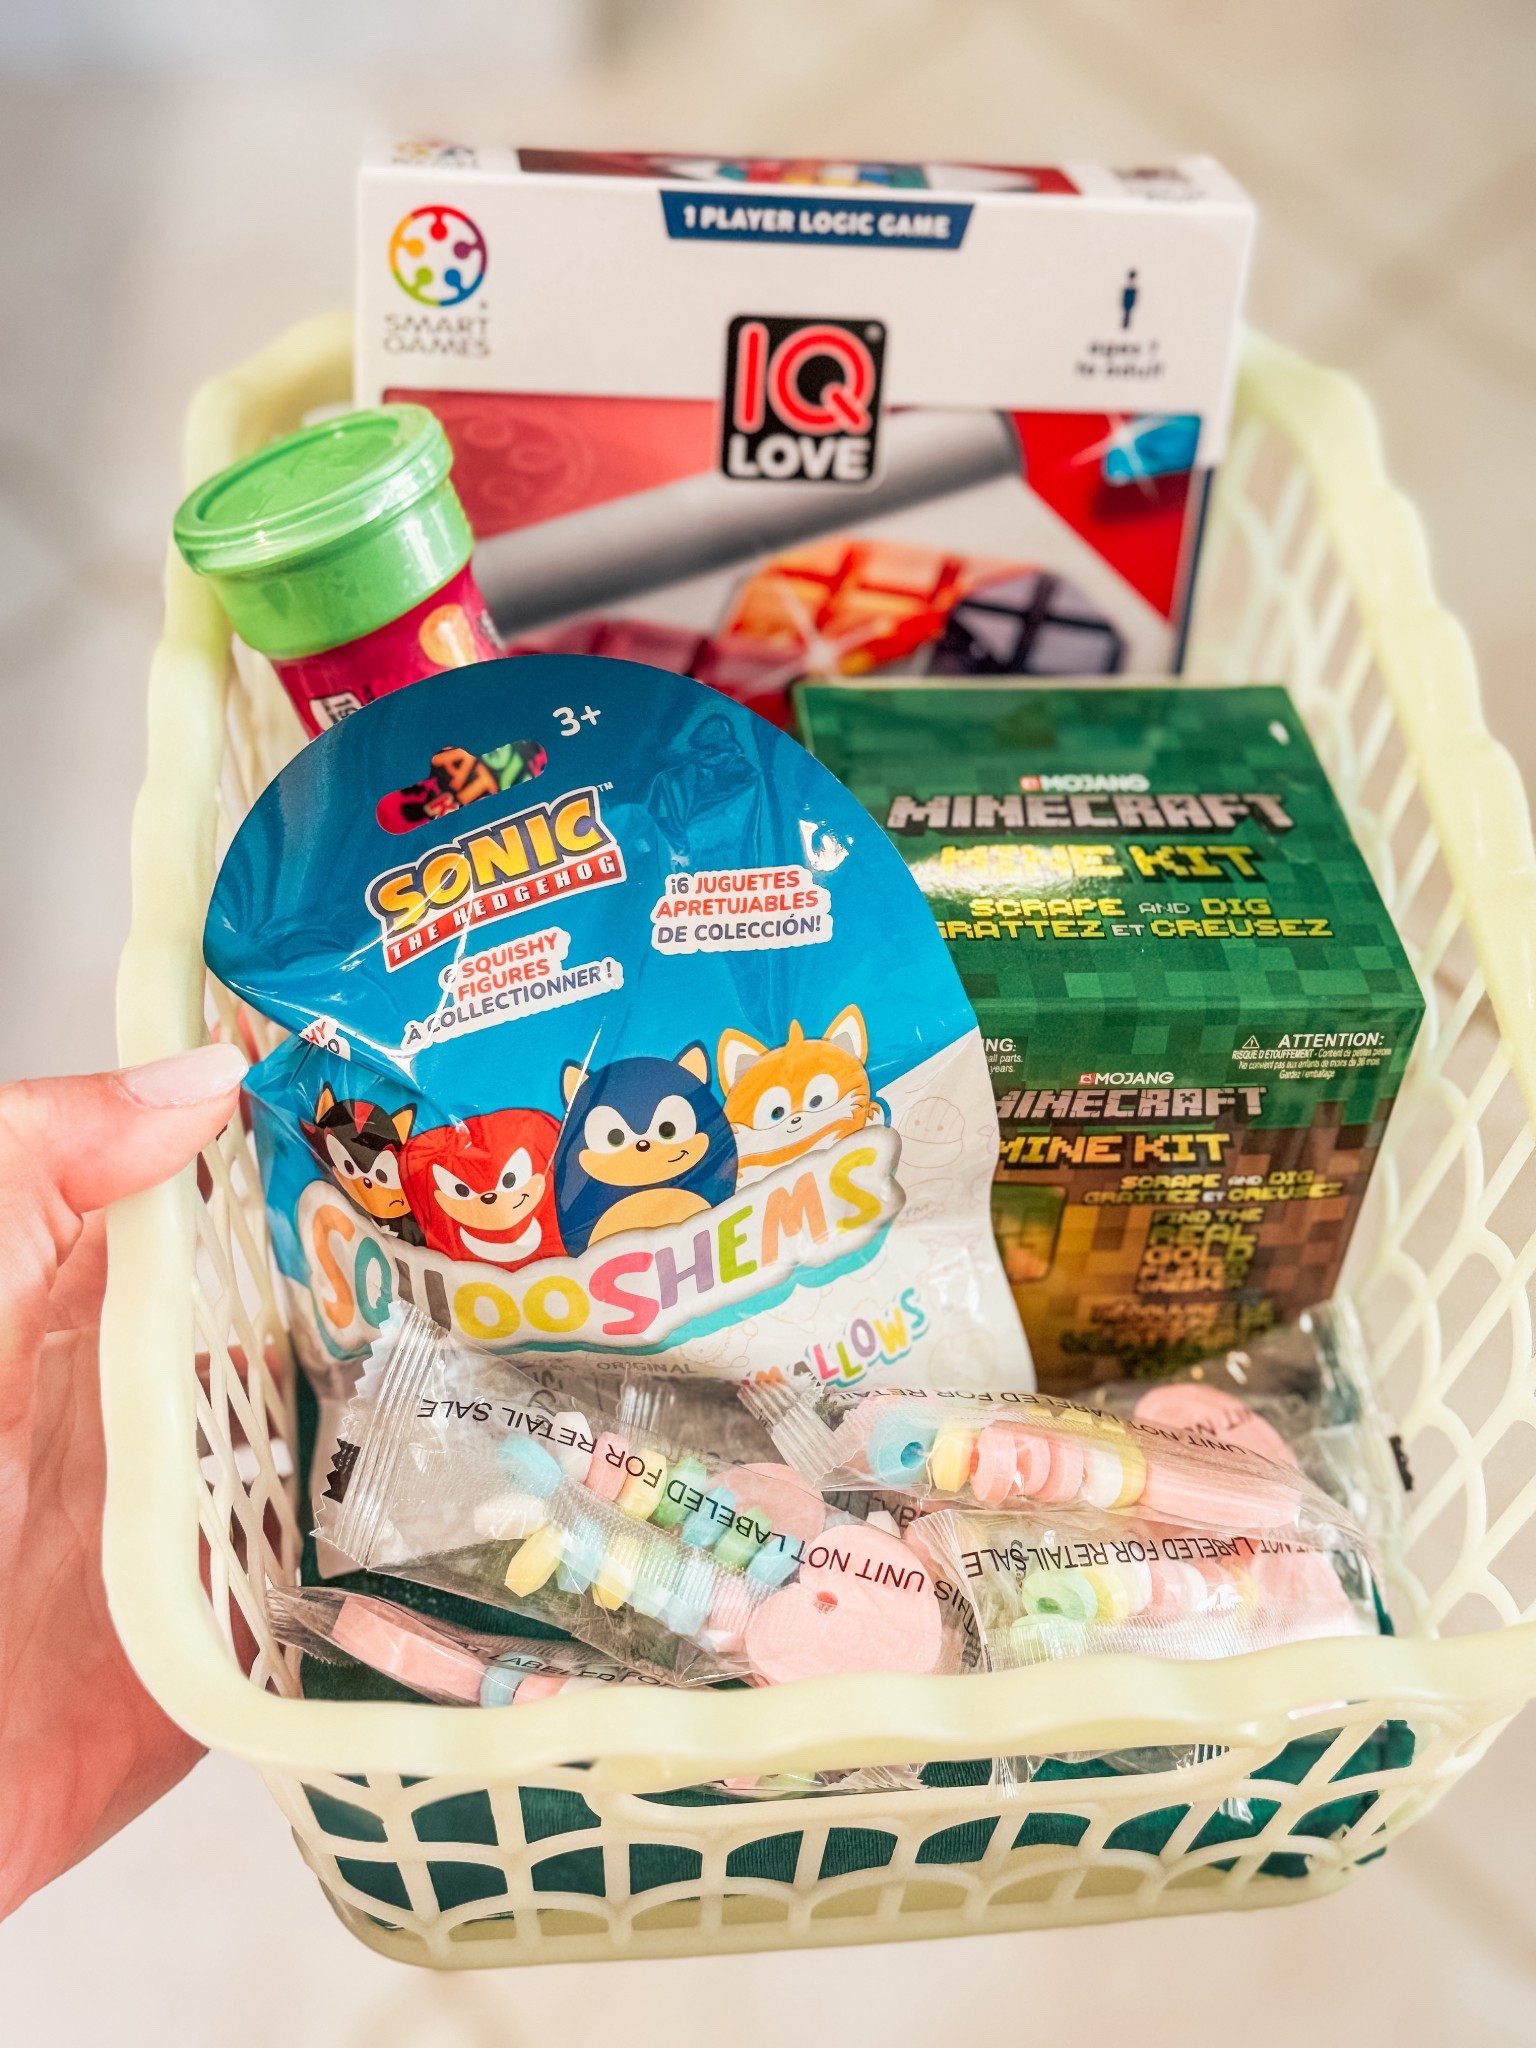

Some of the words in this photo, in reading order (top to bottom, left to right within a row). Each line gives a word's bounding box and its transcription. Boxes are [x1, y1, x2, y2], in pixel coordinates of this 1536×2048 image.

[684, 205, 695, 228] 1
[699, 206, 794, 233] PLAYER
[800, 211, 874, 237] LOGIC
[877, 214, 951, 239] GAME
[384, 314, 490, 335] SMART
[384, 335, 490, 358] GAMES
[735, 322, 876, 436] IQ
[728, 435, 871, 482] LOVE
[553, 705, 602, 736] 3+
[1043, 774, 1151, 792] MOJANG
[887, 795, 1295, 834] MINECRAFT
[375, 794, 610, 934] SONIC
[938, 843, 1128, 880] MINE
[1129, 844, 1264, 881] KIT
[695, 869, 801, 894] JUGUETES
[391, 921, 441, 961] THE
[452, 853, 617, 928] HEDGEHOG
[655, 889, 819, 919] APRETUJABLES
[968, 897, 1126, 918] SCRAPE
[1137, 901, 1191, 916] AND
[1201, 898, 1272, 917] DIG
[657, 925, 688, 944] DE
[694, 913, 822, 942] COLECCIÓN!
[1110, 923, 1145, 937] ET
[1150, 918, 1334, 939] CREUSEZ
[461, 932, 558, 979] SQUISHY
[457, 958, 551, 1002] FIGURES
[406, 1024, 422, 1045] À
[1277, 1032, 1385, 1049] ATTENTION:
[999, 1054, 1024, 1065] parts.
[1231, 1050, 1258, 1060] RISQUE
[1095, 1072, 1175, 1085] MOJANG
[1134, 1133, 1232, 1165] KIT
[1120, 1173, 1222, 1190] SCRAPE
[1227, 1174, 1263, 1187] AND
[1268, 1169, 1316, 1186] DIG
[1083, 1188, 1201, 1204] GRATTEZ
[1202, 1191, 1226, 1203] ET
[1227, 1182, 1344, 1202] CREUSEZ
[1215, 1208, 1264, 1222] THE
[596, 1360, 698, 1376] ORIGINAL
[832, 1388, 928, 1402] RETAIL
[945, 1388, 993, 1402] FOR
[416, 1398, 493, 1422] SALE
[501, 1406, 598, 1455] RETAIL
[1131, 1421, 1182, 1444] NOT
[1198, 1434, 1249, 1456] UNIT
[604, 1443, 667, 1489] FOR
[667, 1478, 787, 1553] LABELED
[790, 1539, 851, 1573] NOT
[1027, 1538, 1108, 1571] RETAIL
[1116, 1540, 1159, 1563] FOR
[1163, 1537, 1251, 1560] LABELED
[960, 1546, 1027, 1579] SALE
[854, 1558, 926, 1593] UNIT
